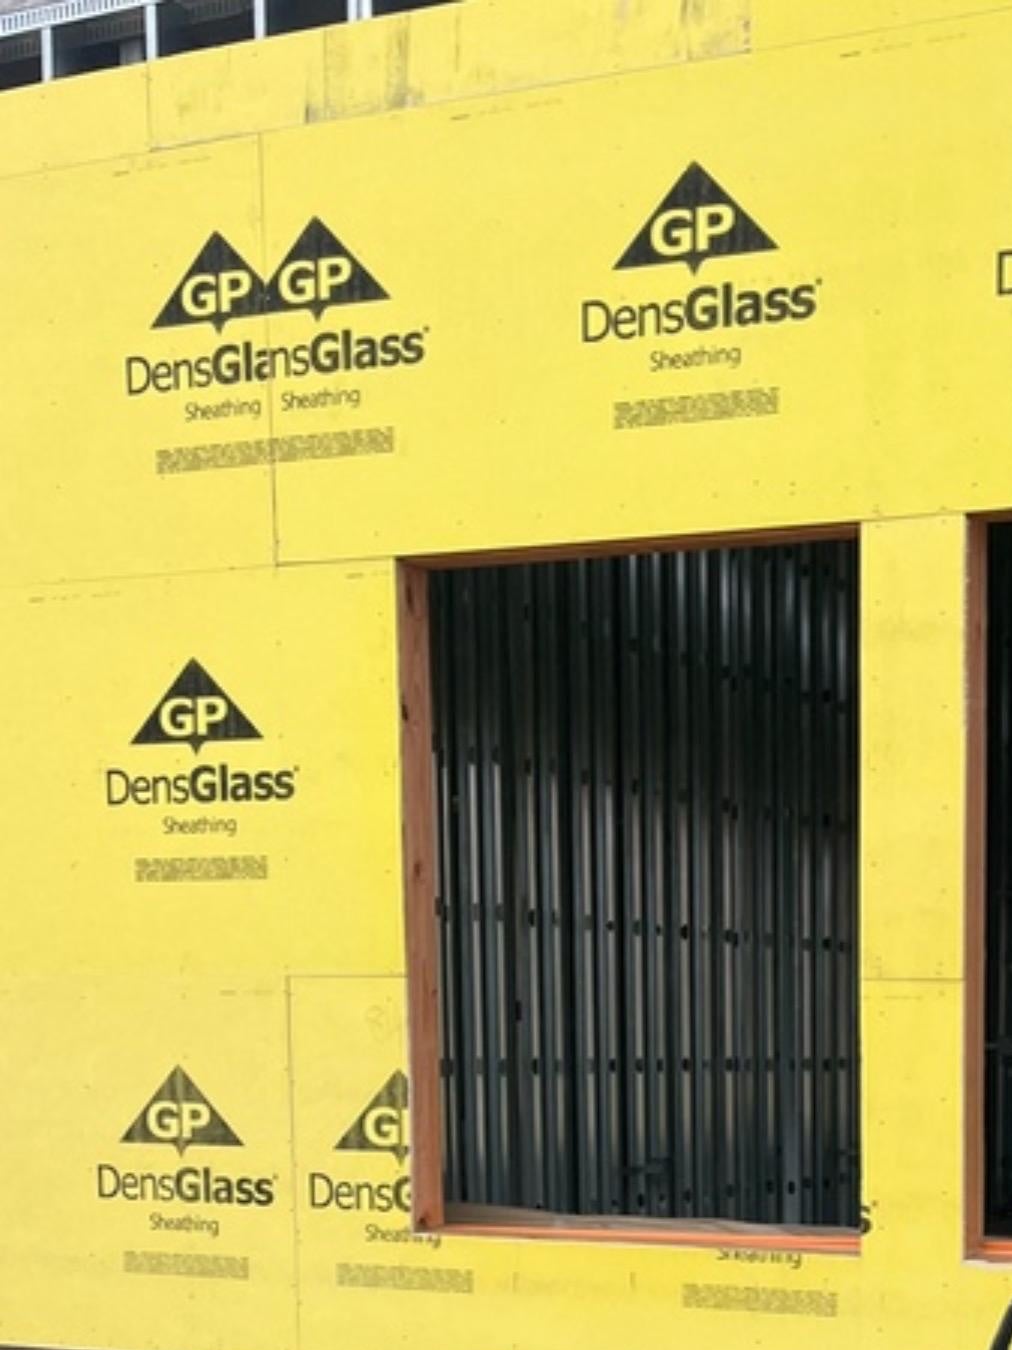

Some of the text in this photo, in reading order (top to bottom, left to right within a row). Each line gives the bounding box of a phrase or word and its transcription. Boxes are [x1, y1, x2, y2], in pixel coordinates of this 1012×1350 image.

[650, 203, 737, 256] GP
[181, 270, 251, 316] GP
[278, 256, 351, 304] GP
[582, 283, 817, 342] DensGlass
[649, 346, 741, 372] Sheathing
[185, 399, 262, 422] Sheathing
[281, 388, 361, 412] Sheathing
[159, 695, 229, 738] GP
[106, 764, 294, 806] DensGlass
[163, 816, 237, 836] Sheathing
[146, 1101, 212, 1140] GP
[98, 1164, 274, 1207] DensGlass
[149, 1213, 219, 1237] Sheathing
